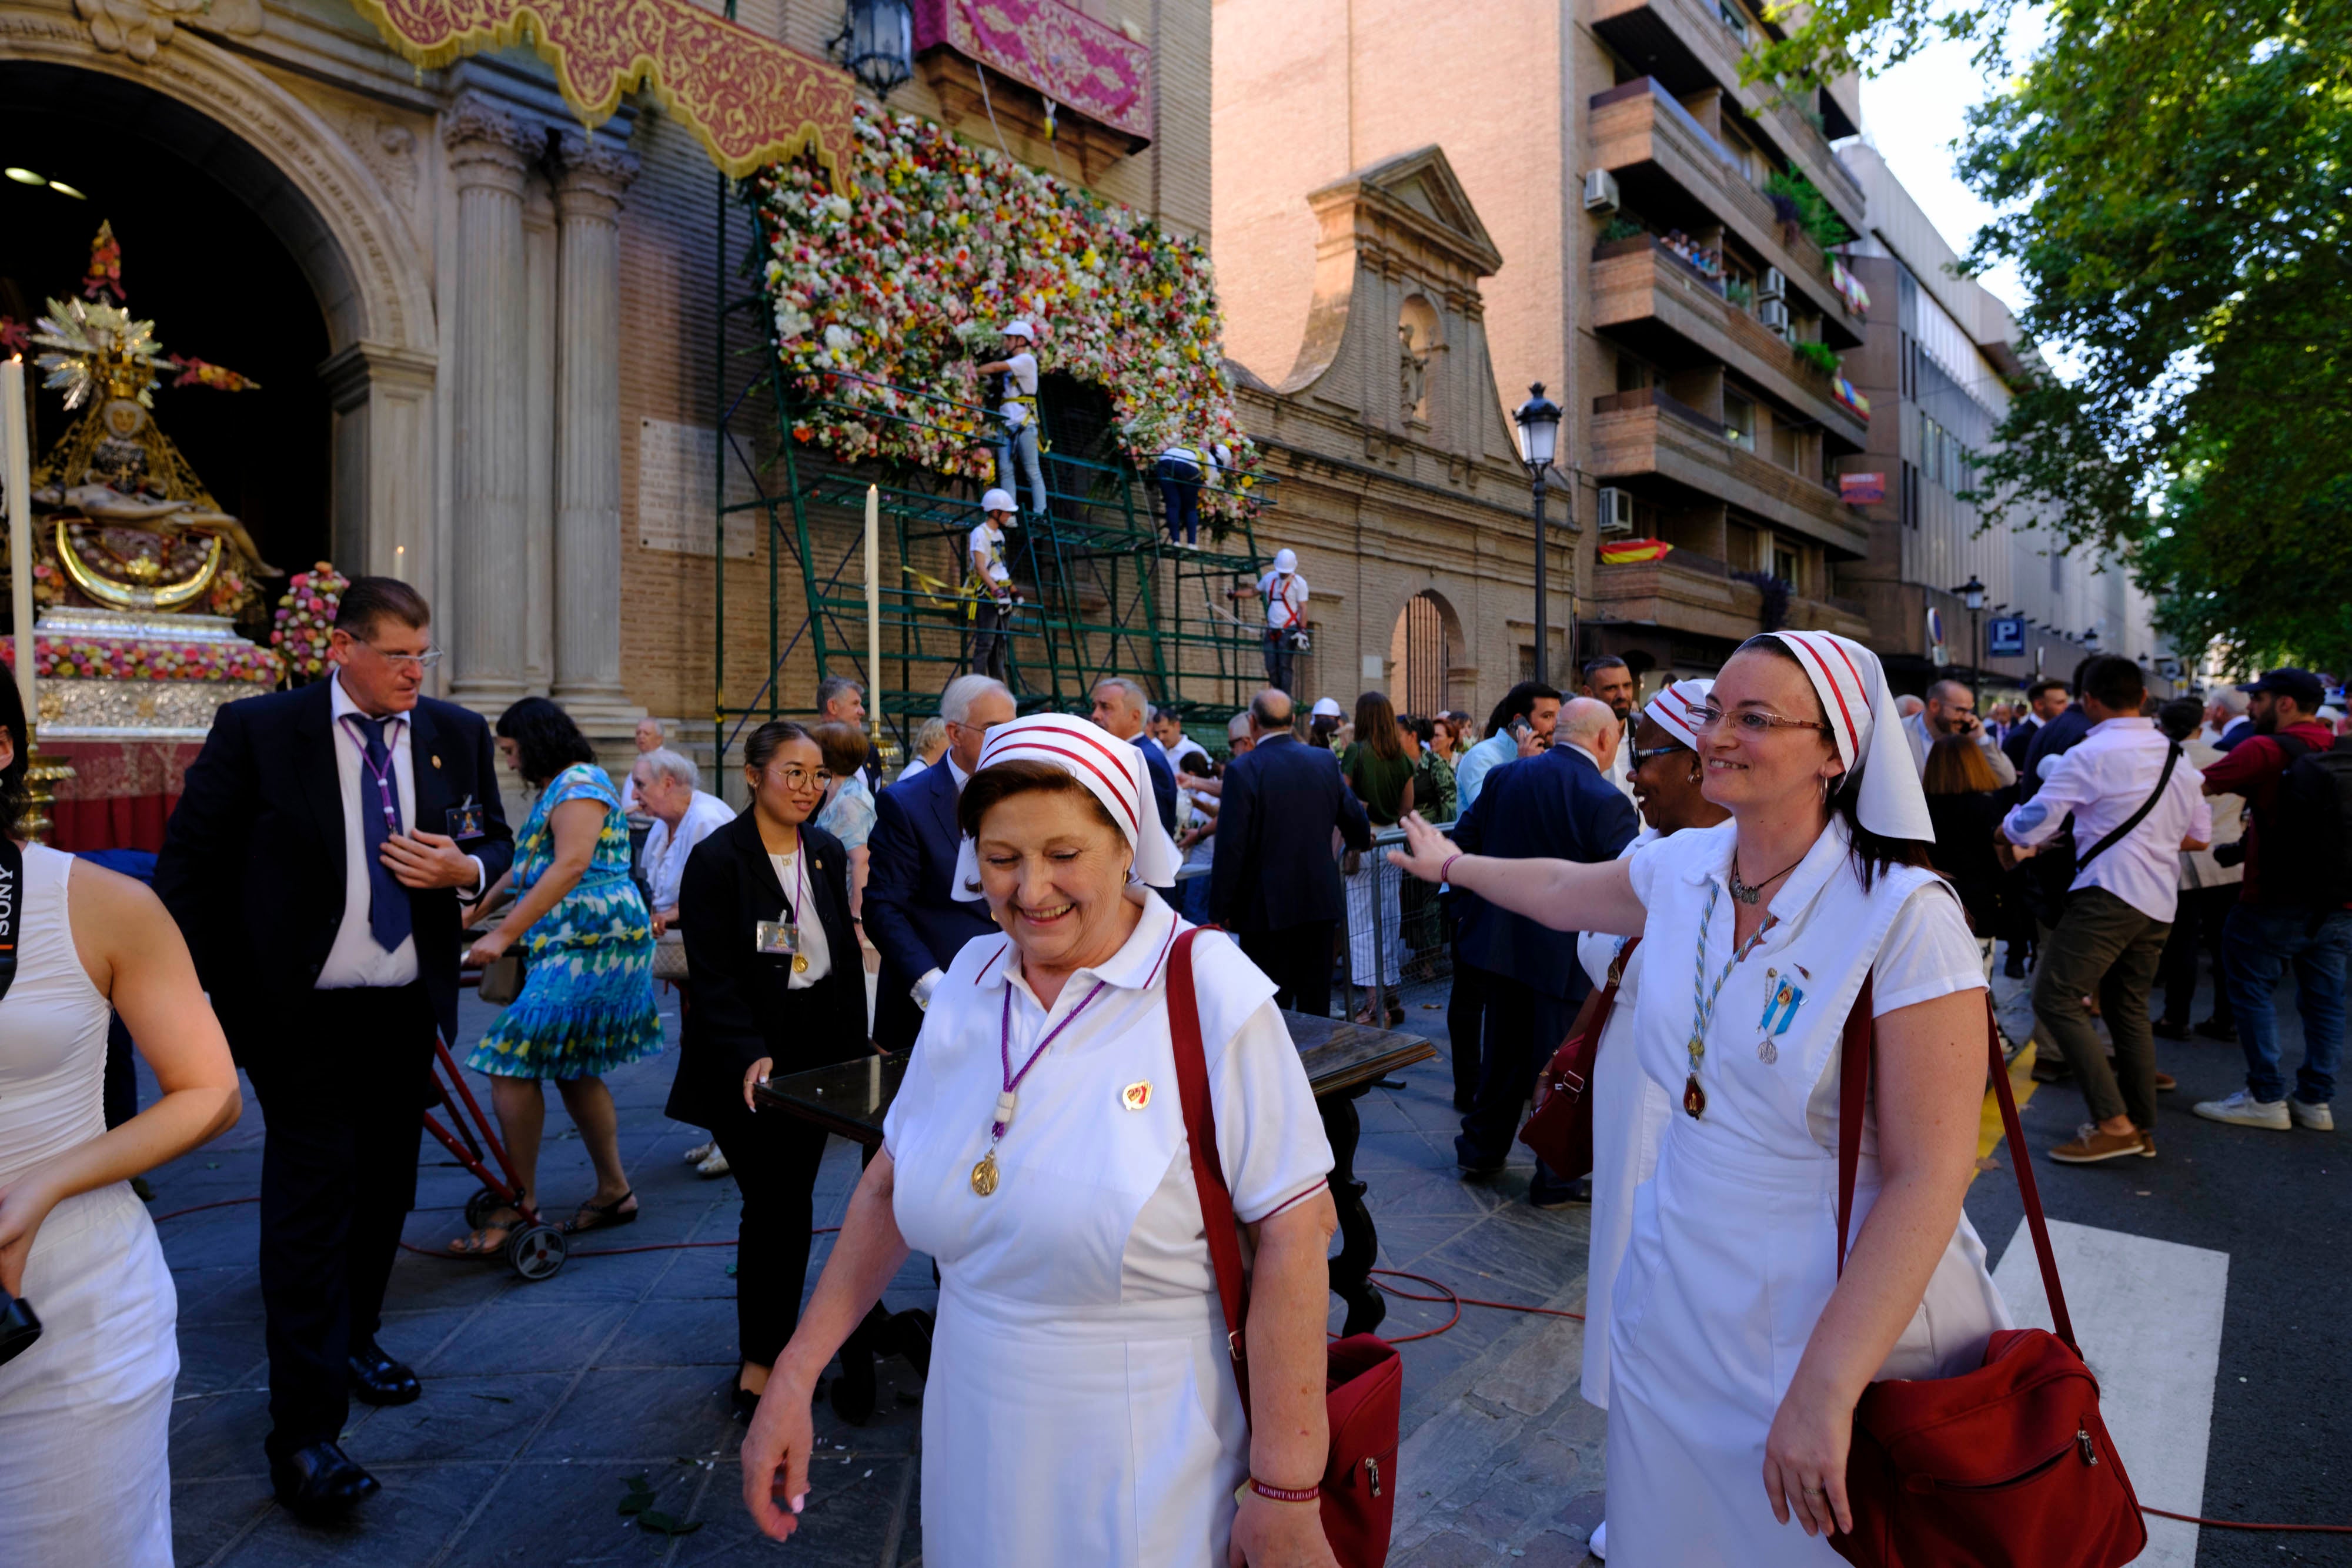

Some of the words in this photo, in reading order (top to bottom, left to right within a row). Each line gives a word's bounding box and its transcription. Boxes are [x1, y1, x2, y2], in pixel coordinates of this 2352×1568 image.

[1997, 621, 2017, 641] P
[0, 864, 13, 936] SONY
[1258, 1483, 1313, 1500] HOSPITALIDAD
